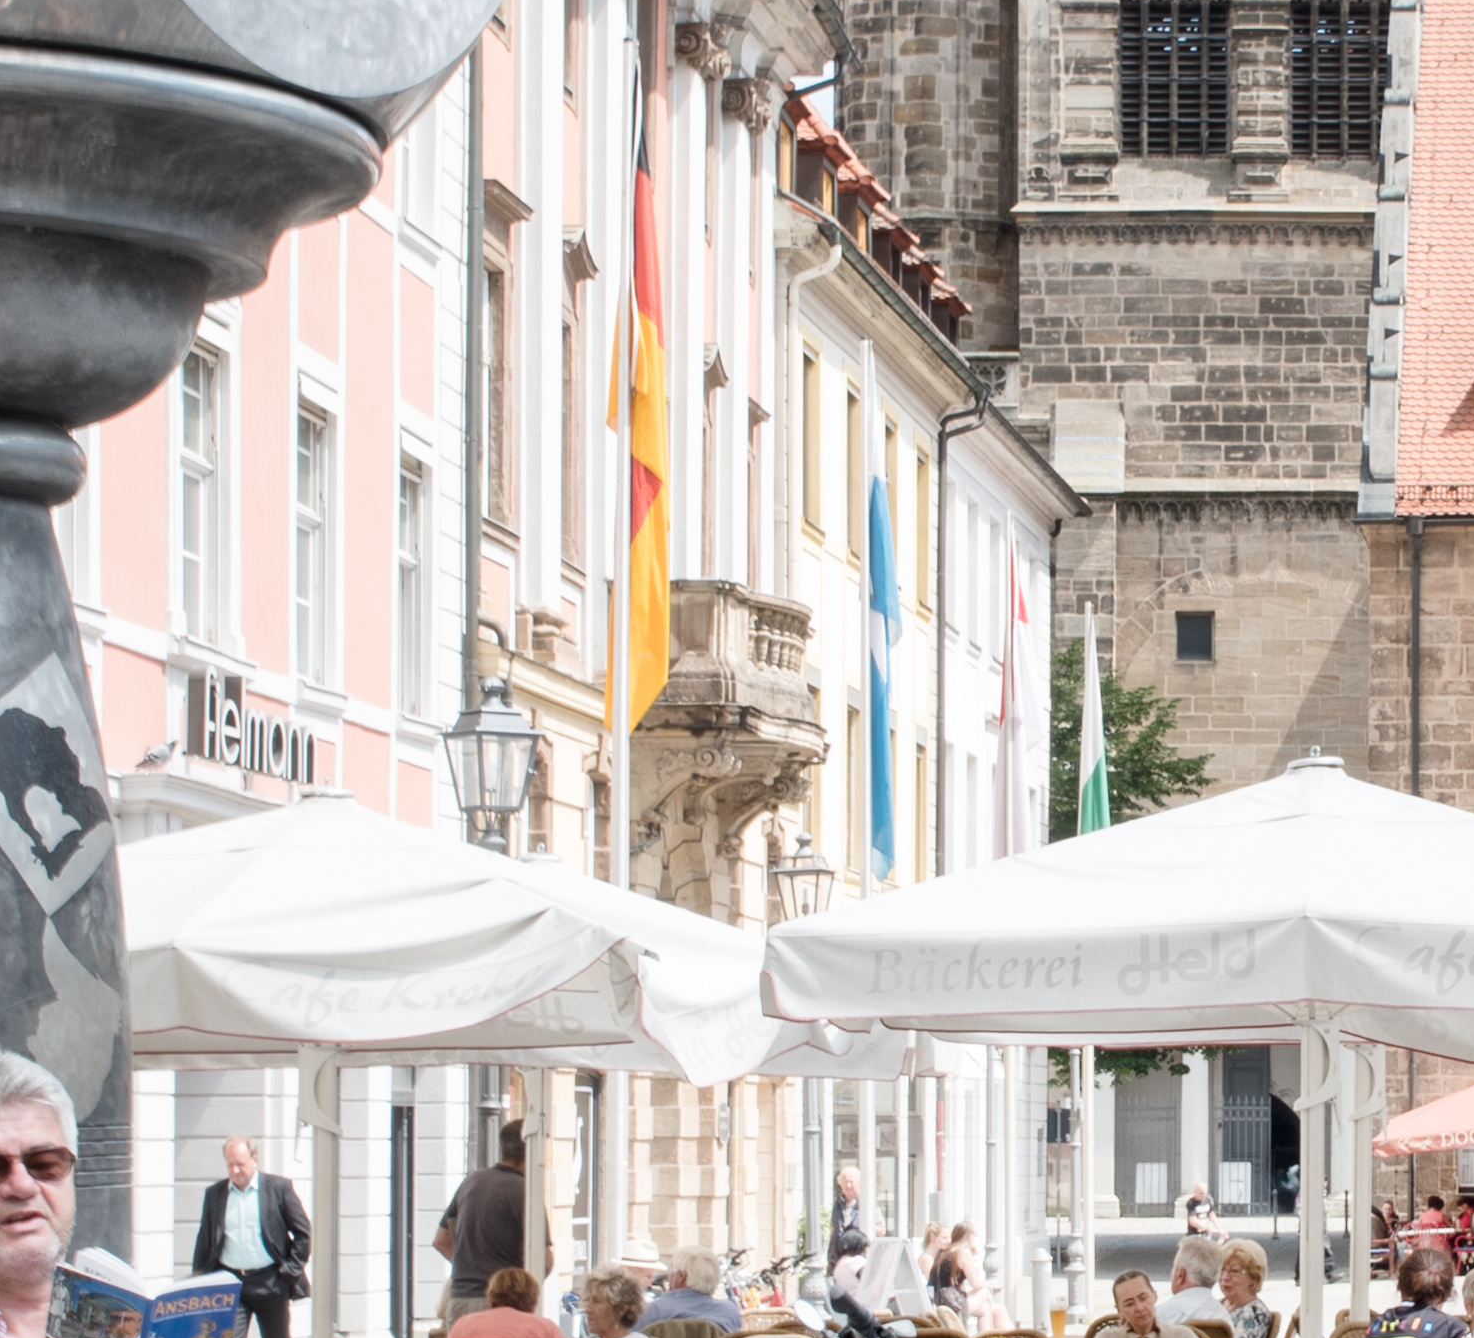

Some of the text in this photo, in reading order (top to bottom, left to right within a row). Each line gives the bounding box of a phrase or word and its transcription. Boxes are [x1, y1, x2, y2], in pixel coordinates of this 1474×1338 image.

[205, 664, 316, 785] fielmann
[867, 928, 1257, 996] Bäckerei Held
[153, 1293, 236, 1319] ANSBACH
